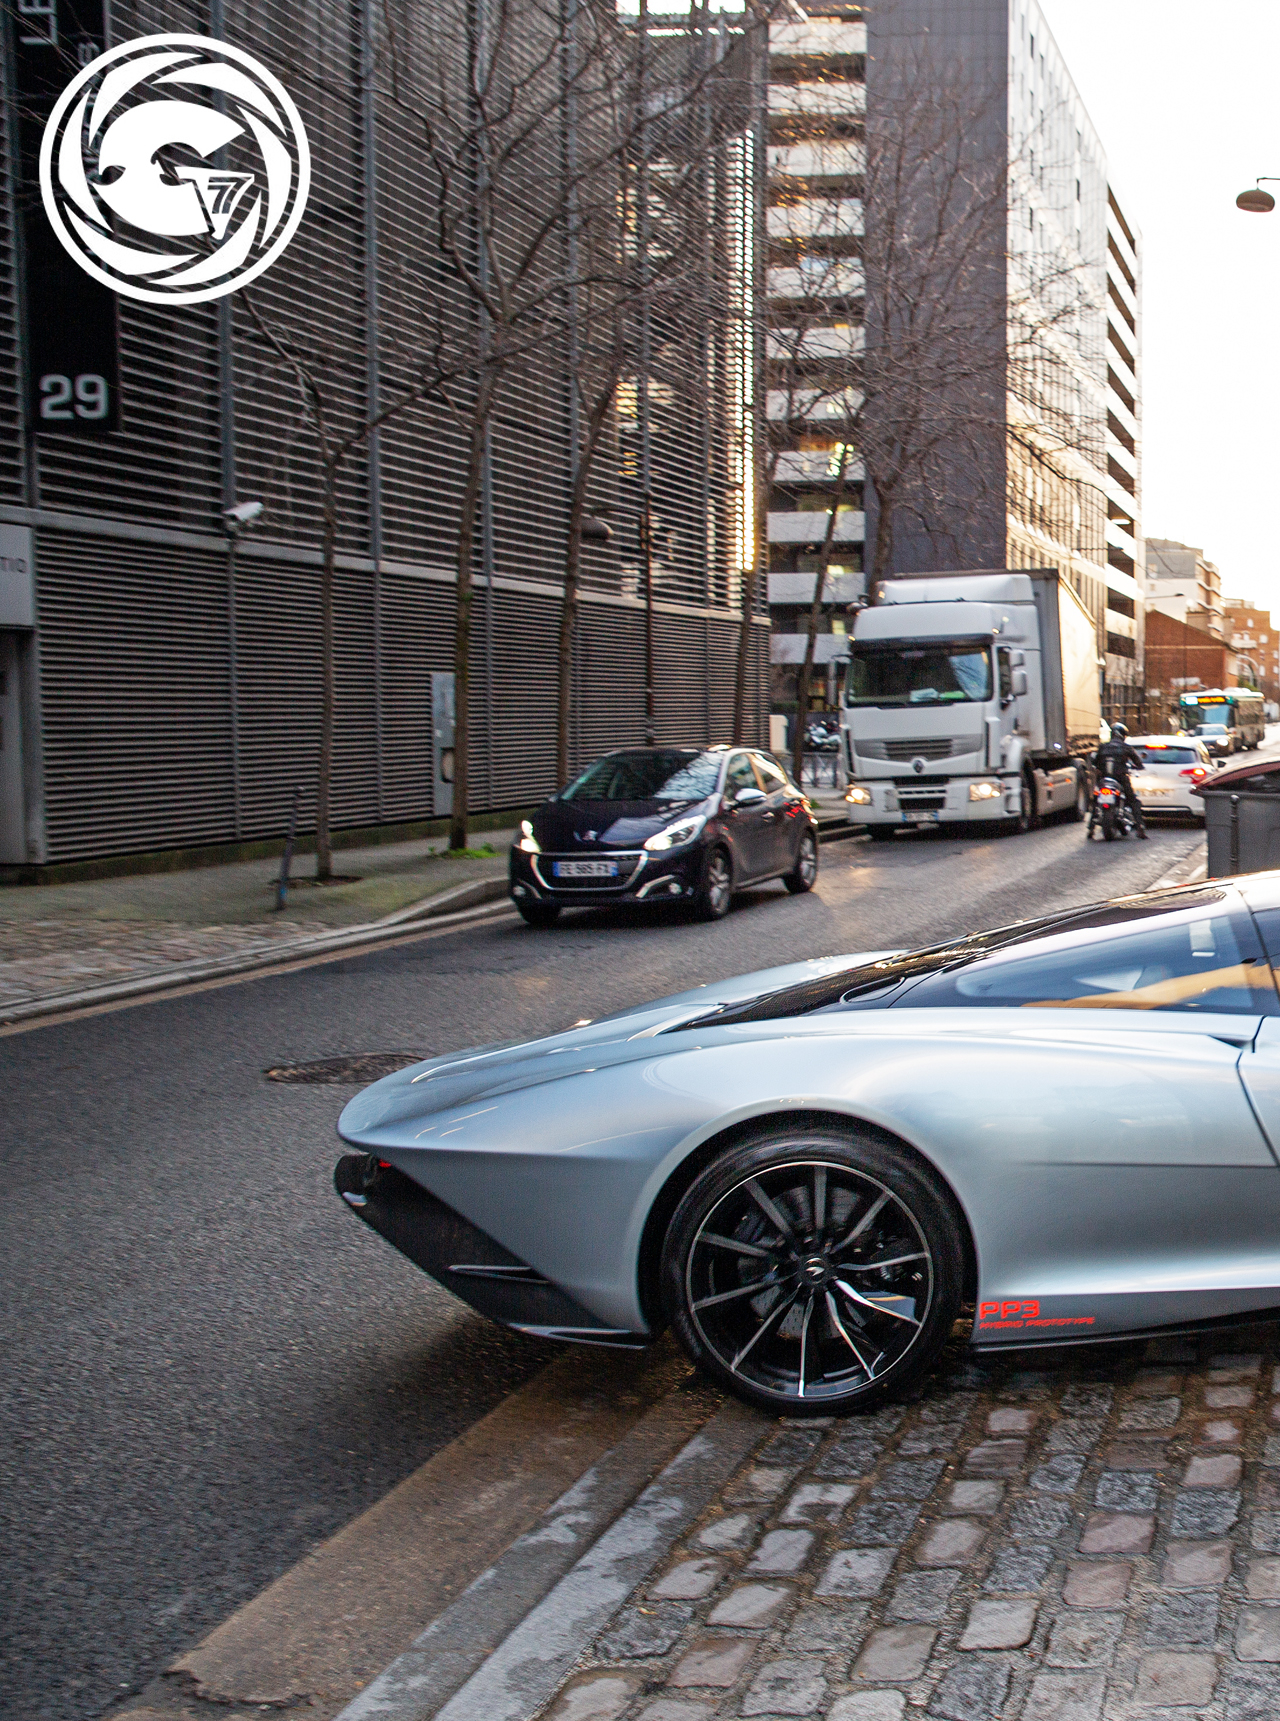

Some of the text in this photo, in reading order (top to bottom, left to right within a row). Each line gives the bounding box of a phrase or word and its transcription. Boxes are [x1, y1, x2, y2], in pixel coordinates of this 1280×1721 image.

[39, 373, 108, 420] 29
[979, 1300, 1040, 1320] PP3
[979, 1317, 1095, 1330] HYBRID PROTOTYPE
